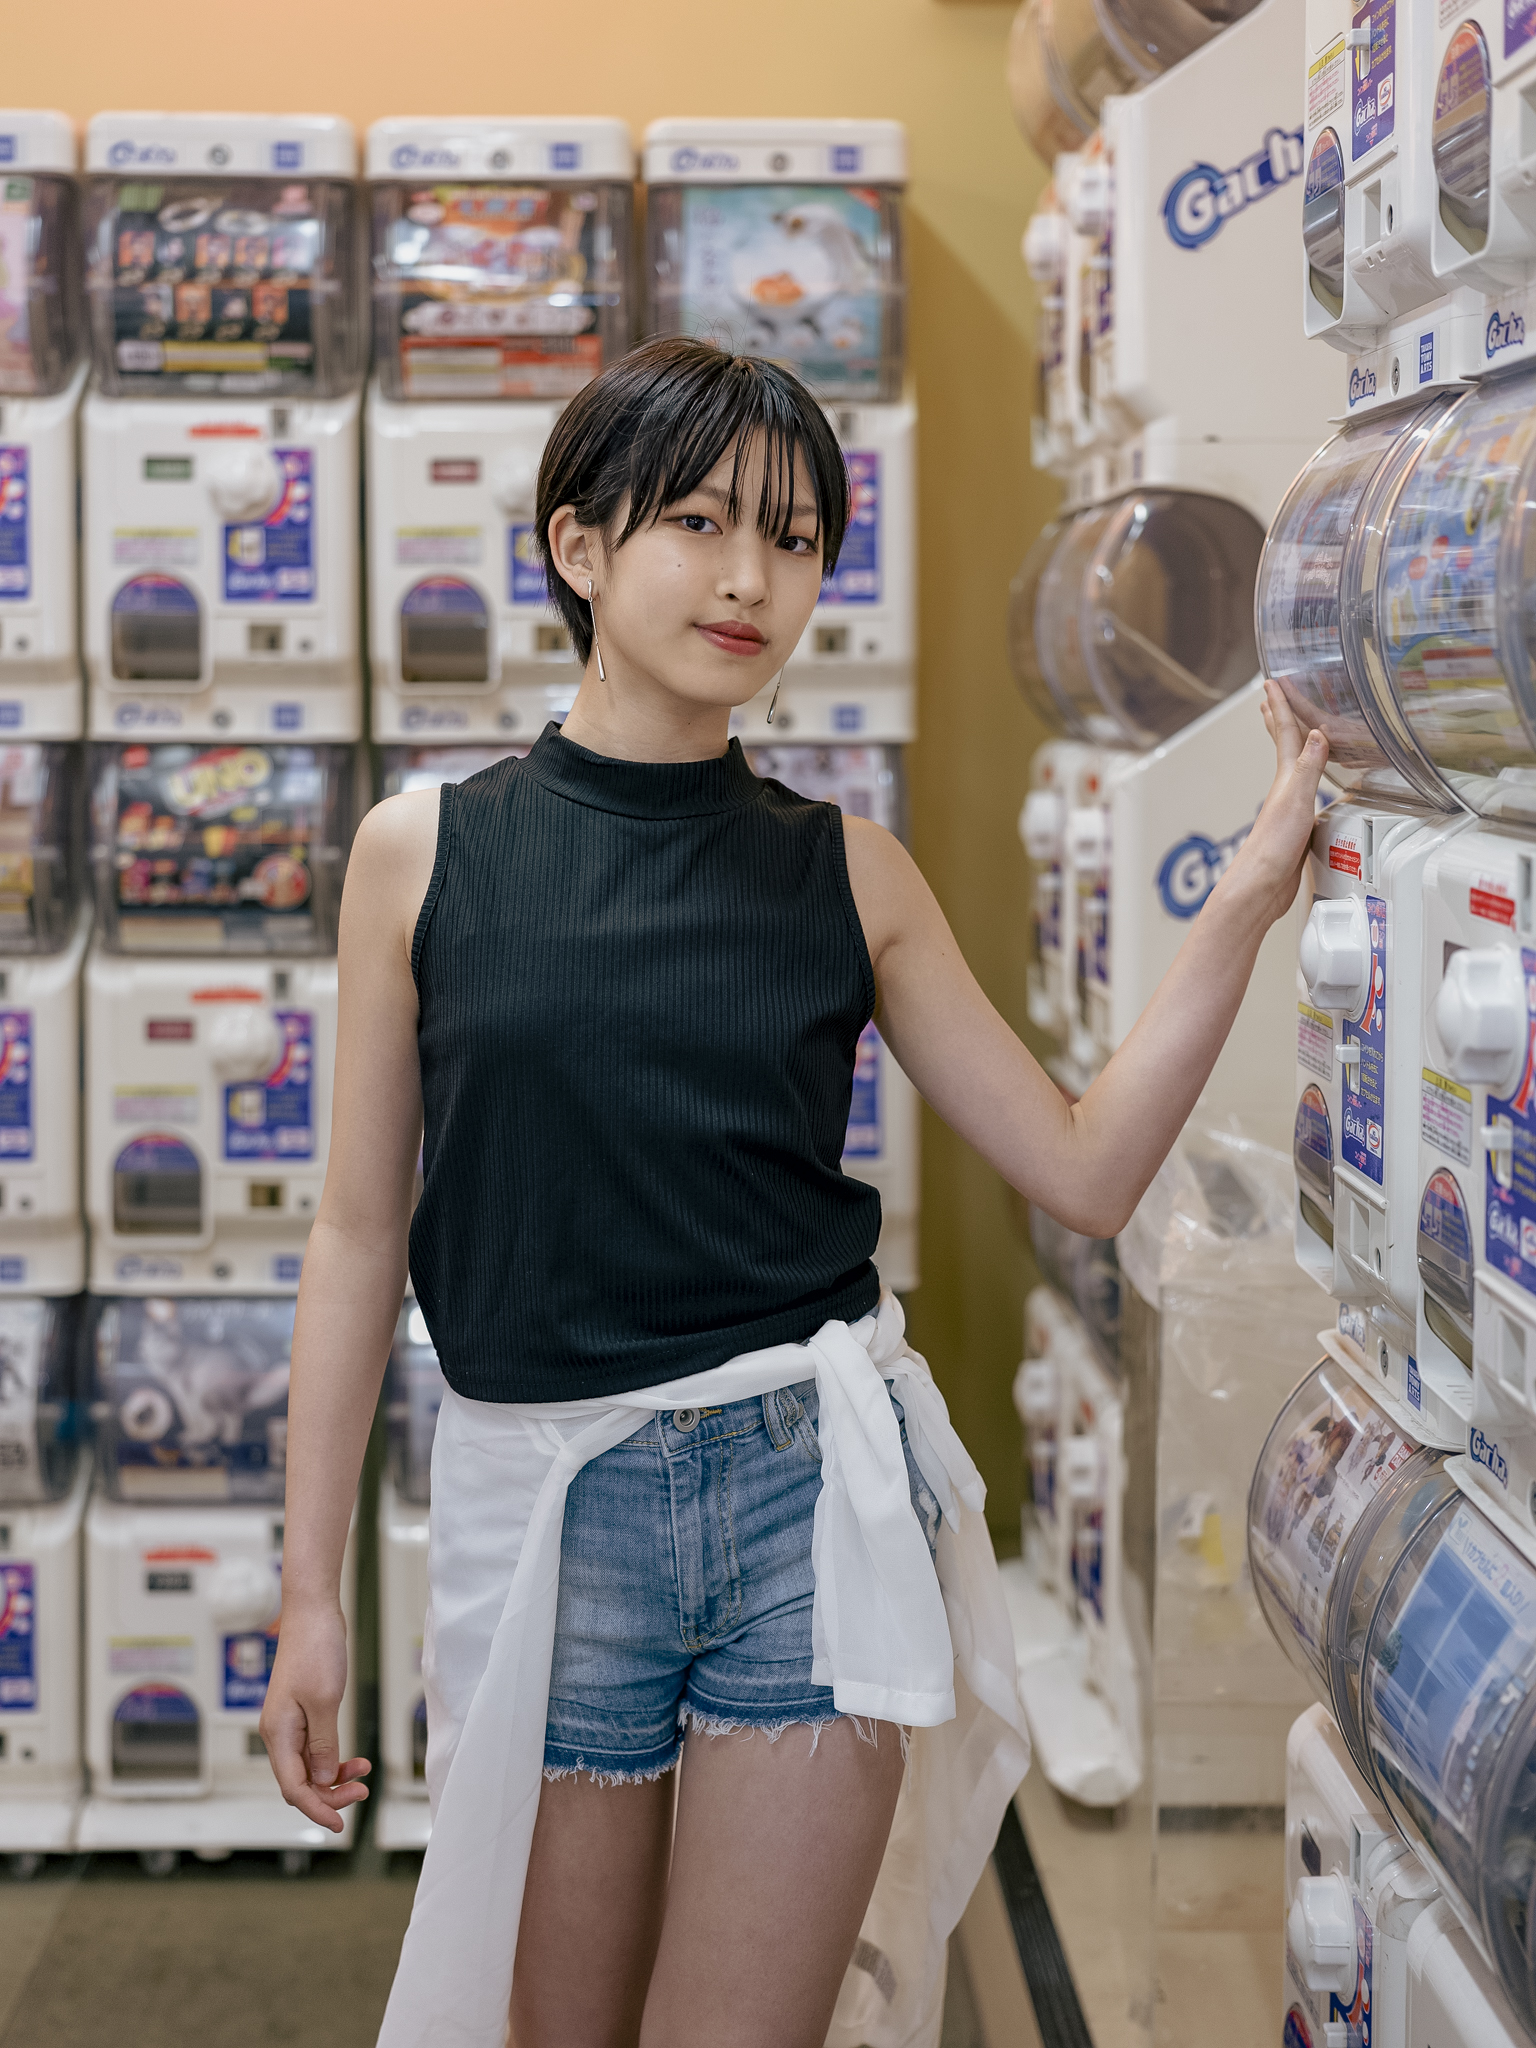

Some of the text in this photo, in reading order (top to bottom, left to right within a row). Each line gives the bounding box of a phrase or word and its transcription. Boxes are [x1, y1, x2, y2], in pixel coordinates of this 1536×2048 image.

[1161, 127, 1304, 250] Gach
[1485, 310, 1525, 360] Gacha
[1349, 367, 1376, 407] Gacha
[1344, 1106, 1365, 1147] Gacha
[1470, 1427, 1508, 1490] Gacha
